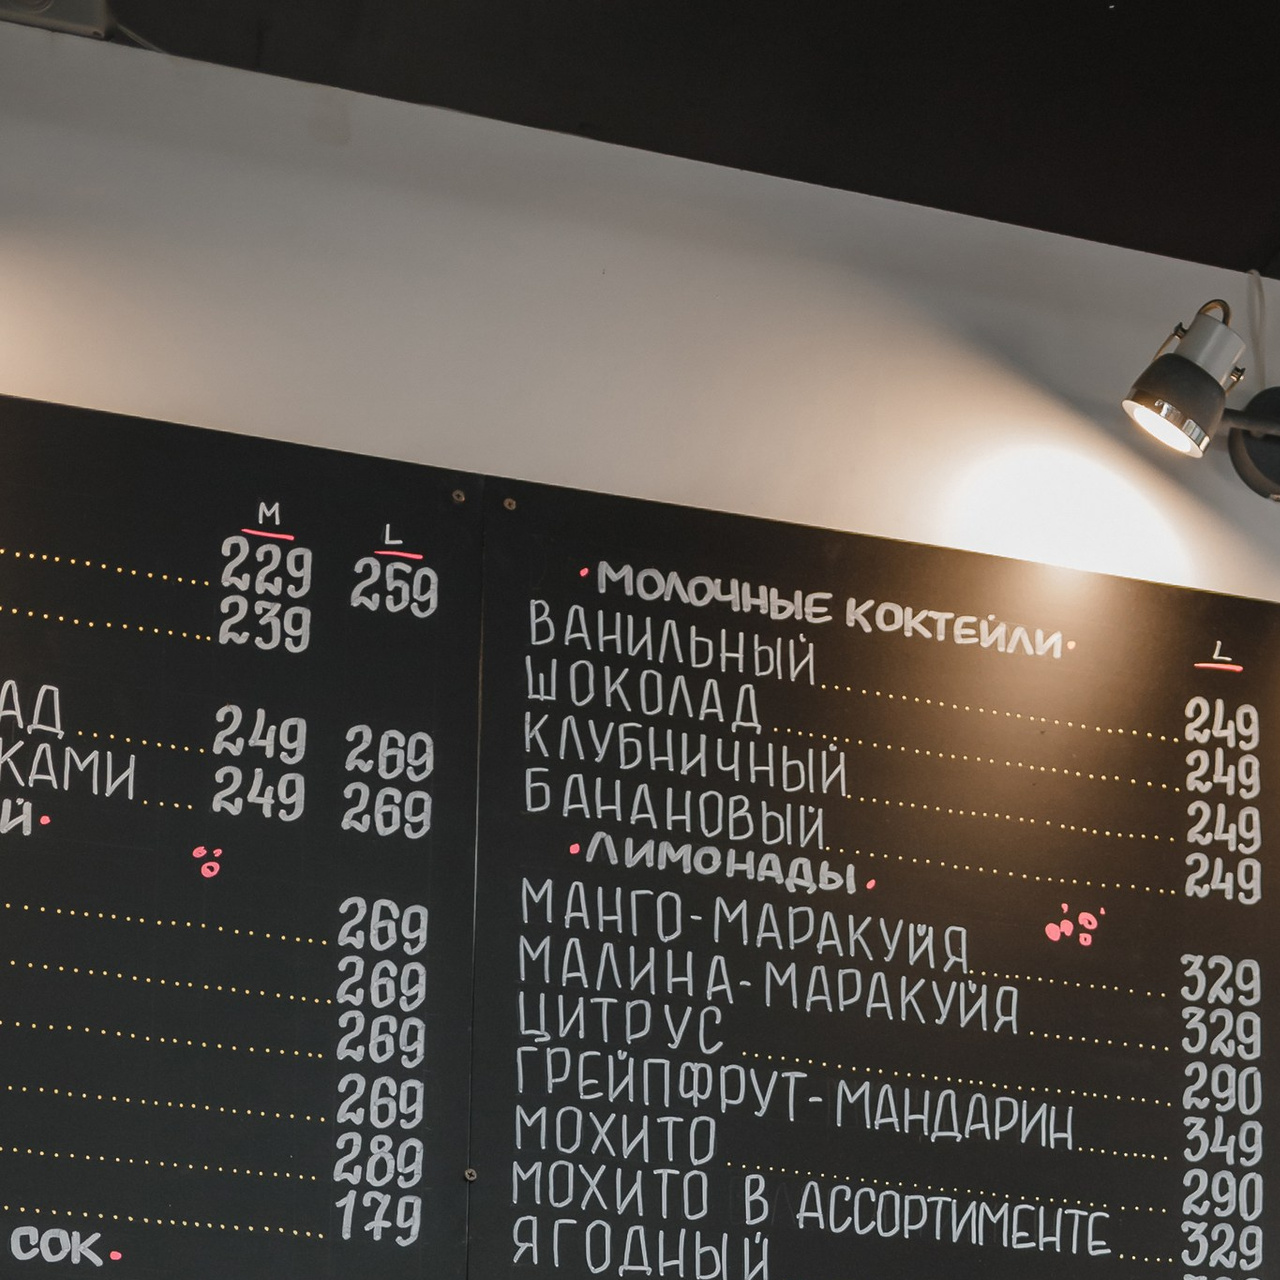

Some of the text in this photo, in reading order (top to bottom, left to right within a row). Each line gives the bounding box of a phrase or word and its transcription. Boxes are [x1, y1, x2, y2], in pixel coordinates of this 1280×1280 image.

[259, 502, 403, 544] M L
[221, 535, 438, 618] 229 259
[219, 595, 311, 653] 239
[598, 561, 1062, 659] МОЛОЧНЫЕ КОКТЕЙЛИ
[530, 600, 1260, 751] ВАНИЛЬНЫЙ 249
[1213, 640, 1232, 661] L
[213, 705, 306, 764] 249
[345, 725, 434, 782] 269
[526, 655, 1261, 800] ШОКОЛАД 249
[212, 766, 305, 821] 249
[341, 782, 431, 839] 269
[525, 712, 1262, 854] КЛУБНИЧНЫЙ 249
[526, 768, 1262, 905] БАНАНОВЫЙ 249
[586, 831, 856, 894] ЛИМОНАДЫ
[338, 896, 428, 955] 269
[336, 956, 427, 1012] 269
[1180, 953, 1262, 1007] 329
[336, 1010, 425, 1068] 269
[518, 991, 1262, 1116] ЦИТРУС 290
[1181, 1007, 1262, 1060] 329
[335, 1073, 424, 1129] 269
[333, 1132, 424, 1188] 289
[515, 1105, 1263, 1221] МОХИТО 290
[1182, 1115, 1263, 1167] 349
[334, 1190, 421, 1247] 179
[512, 1161, 1263, 1271] МОХИТО В АССОРТИМЕНТЕ 329
[10, 1226, 103, 1267] СОК
